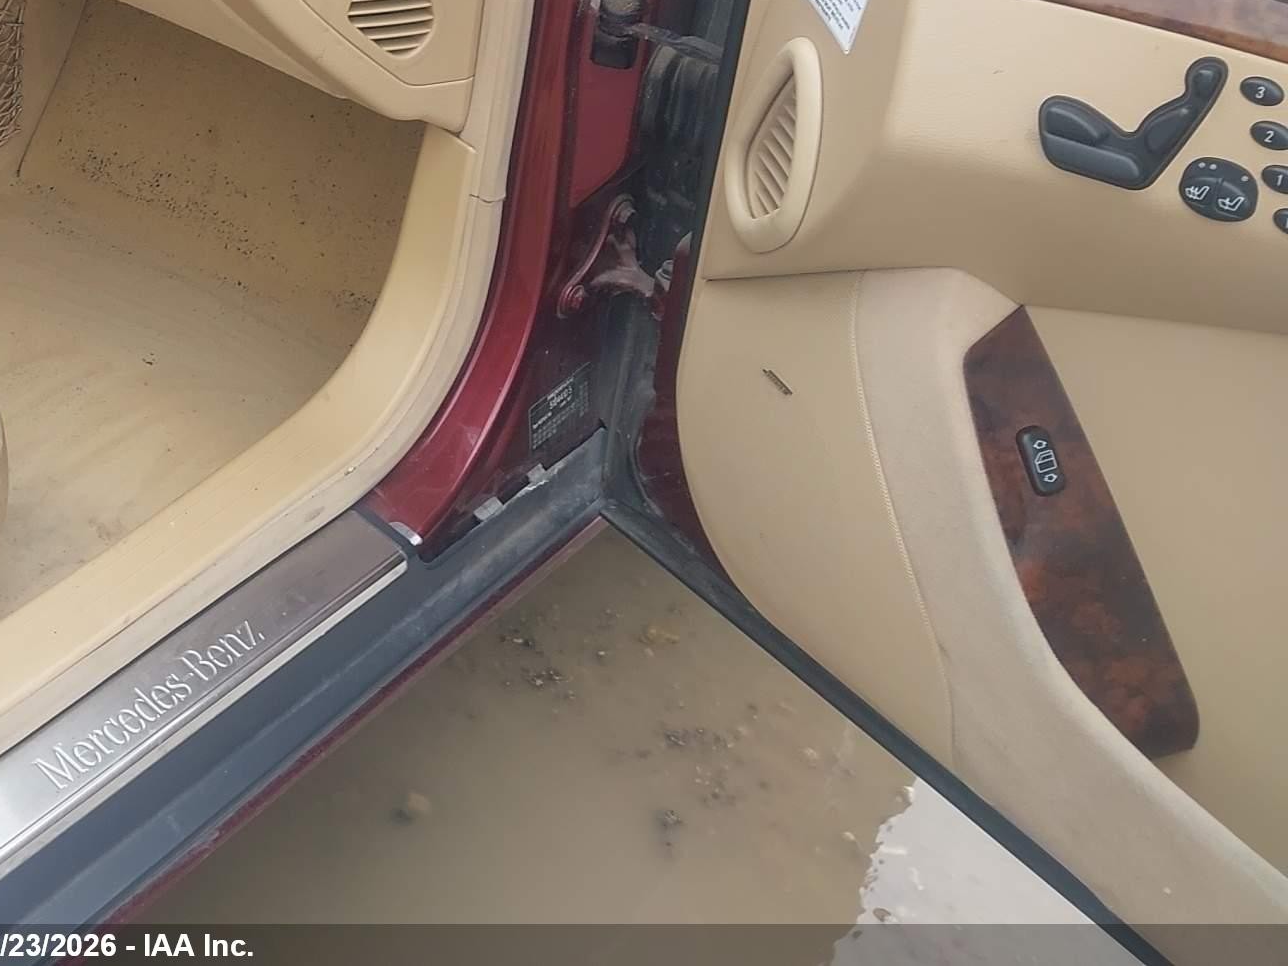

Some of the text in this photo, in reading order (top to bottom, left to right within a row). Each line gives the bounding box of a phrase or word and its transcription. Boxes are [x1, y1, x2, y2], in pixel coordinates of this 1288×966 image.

[1255, 86, 1266, 99] 3
[1263, 130, 1275, 143] 2
[1276, 174, 1284, 187] 1
[32, 620, 265, 790] Mercedes-Benz
